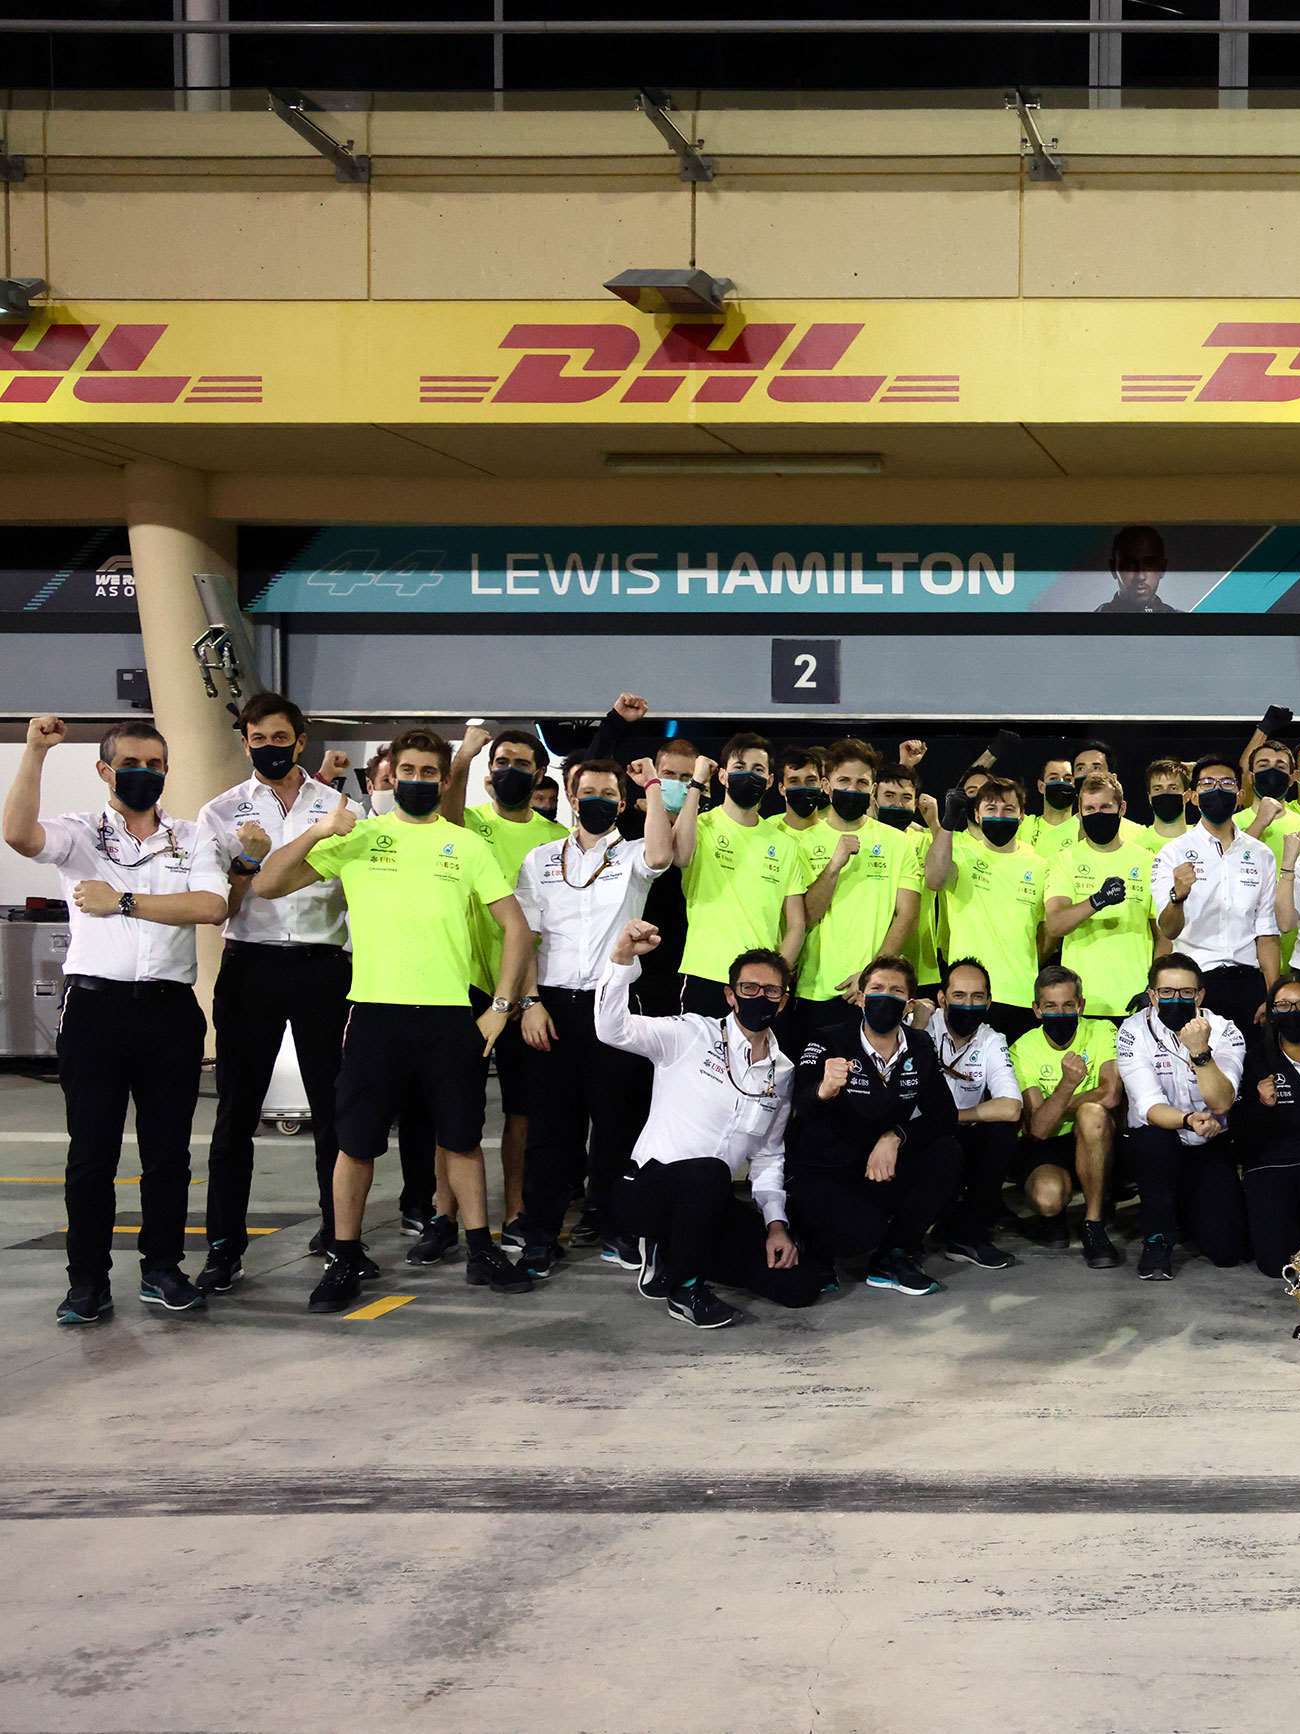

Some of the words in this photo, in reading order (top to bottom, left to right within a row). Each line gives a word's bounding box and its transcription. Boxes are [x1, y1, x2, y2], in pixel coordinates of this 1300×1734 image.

[0, 323, 192, 404] HL
[490, 322, 889, 404] DHL
[95, 574, 120, 586] WE
[306, 549, 447, 596] 44
[471, 552, 661, 595] LEWIS
[676, 551, 1015, 595] HAMILTON
[95, 587, 119, 597] AS
[792, 653, 818, 689] 2
[711, 1062, 727, 1075] UBS
[899, 1078, 919, 1087] INEOS
